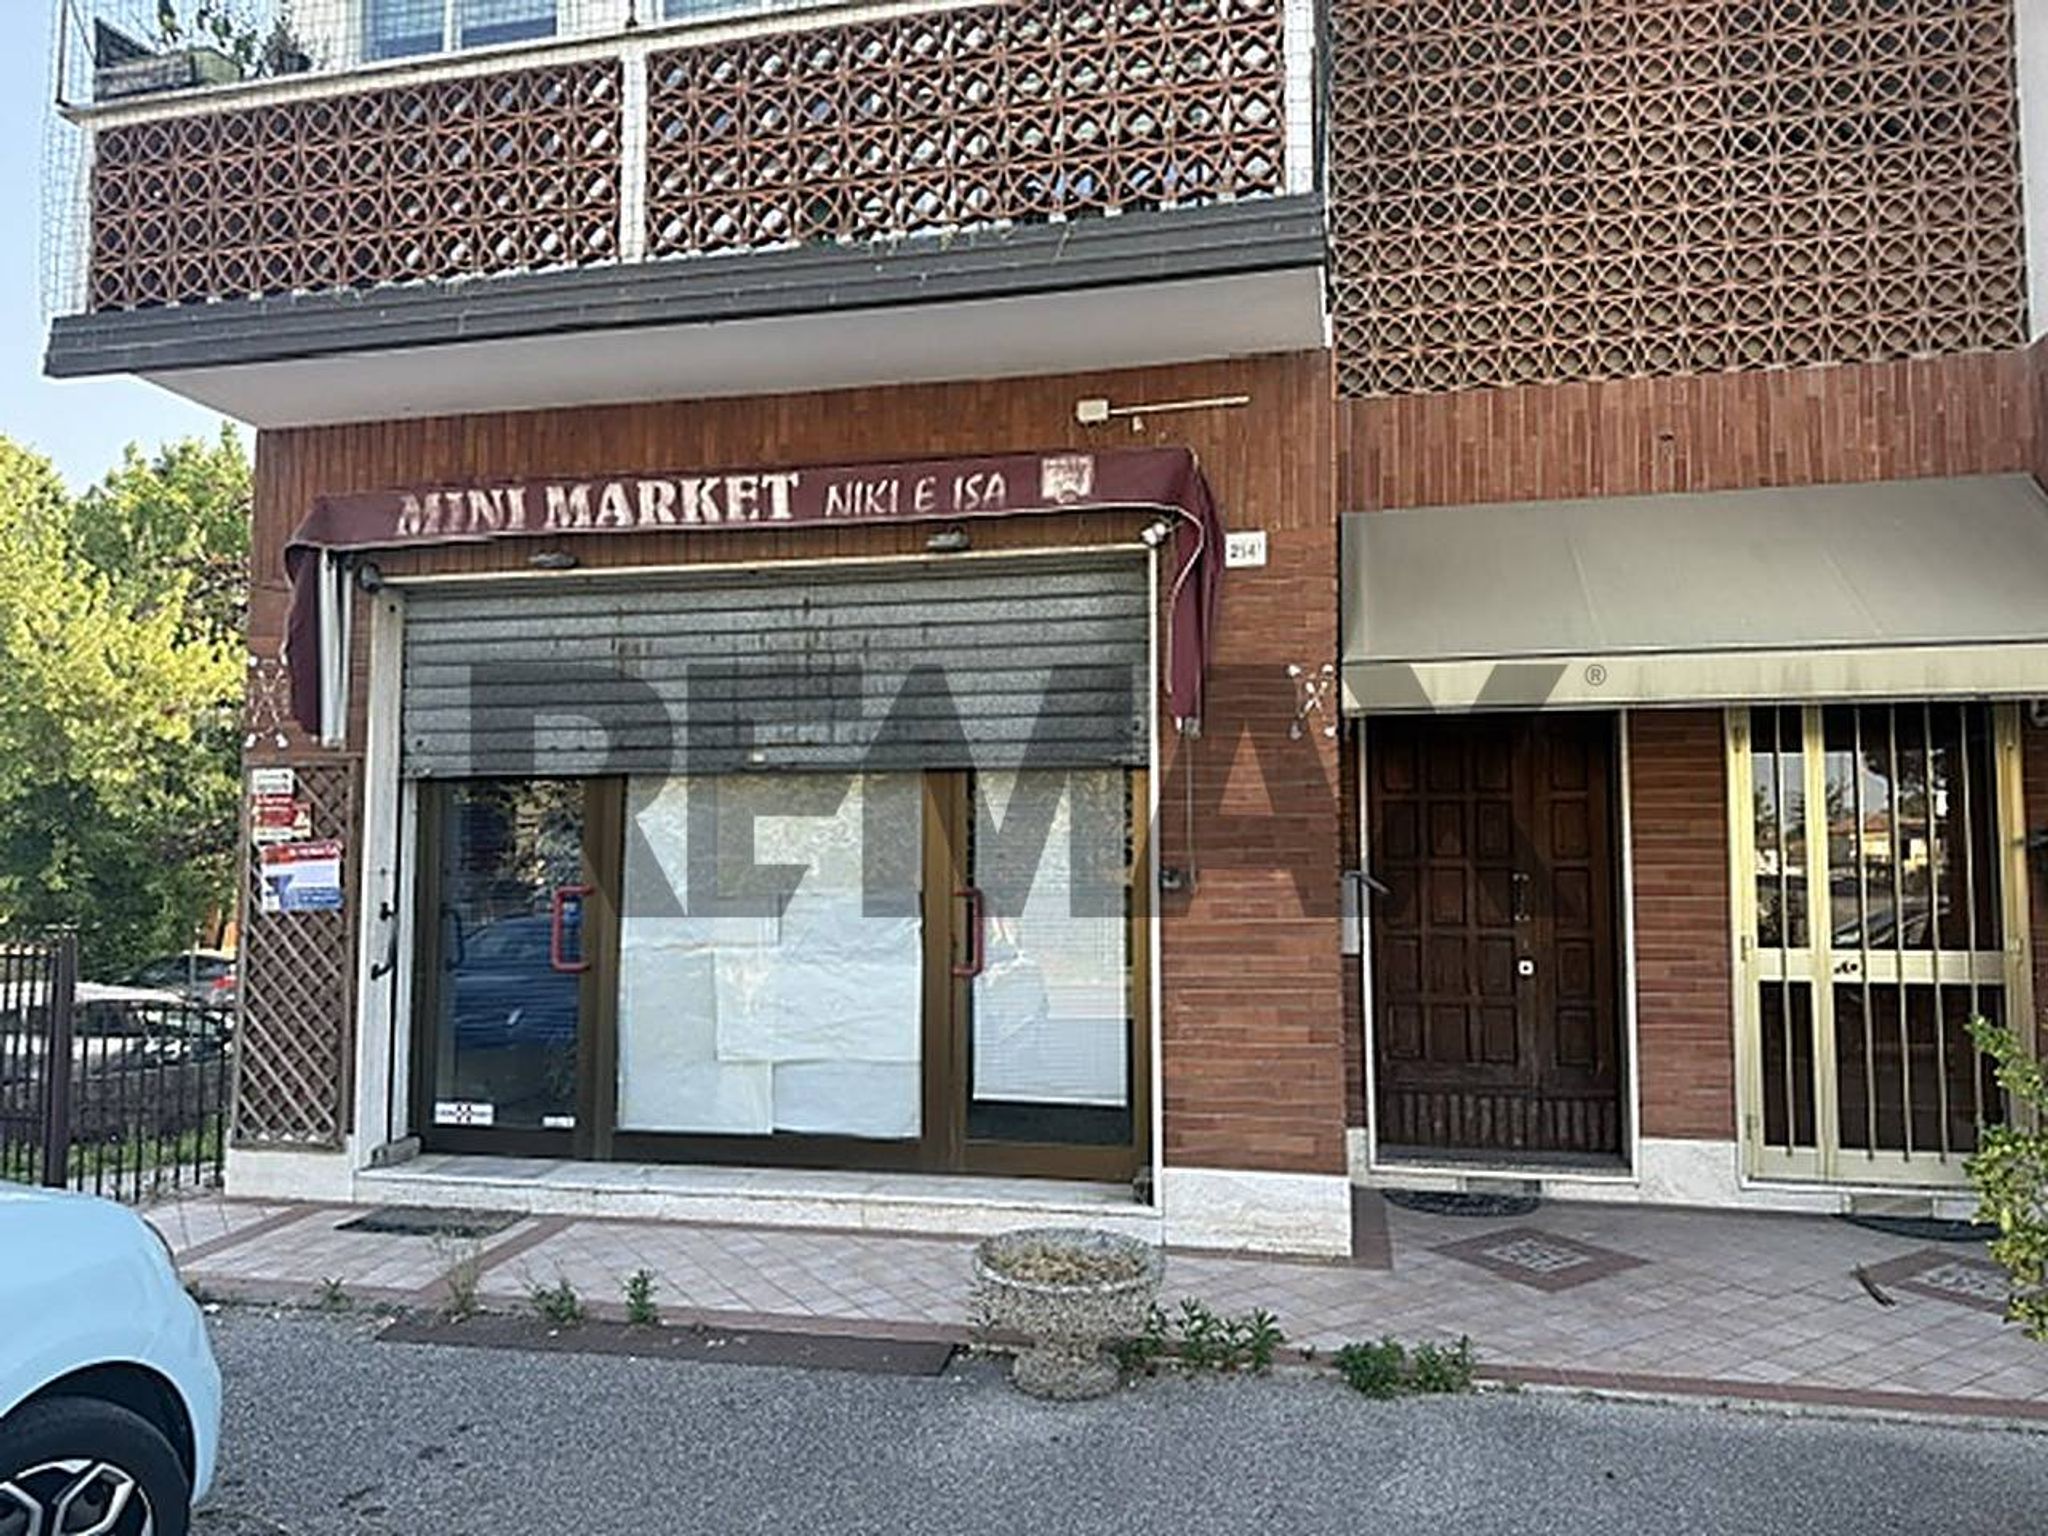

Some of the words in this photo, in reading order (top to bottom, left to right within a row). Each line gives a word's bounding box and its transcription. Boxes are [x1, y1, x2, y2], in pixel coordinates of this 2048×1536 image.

[396, 485, 527, 536] MINI
[543, 471, 799, 530] MARKET
[825, 478, 898, 517] NIKI
[914, 475, 937, 513] E
[952, 471, 1006, 511] ISA
